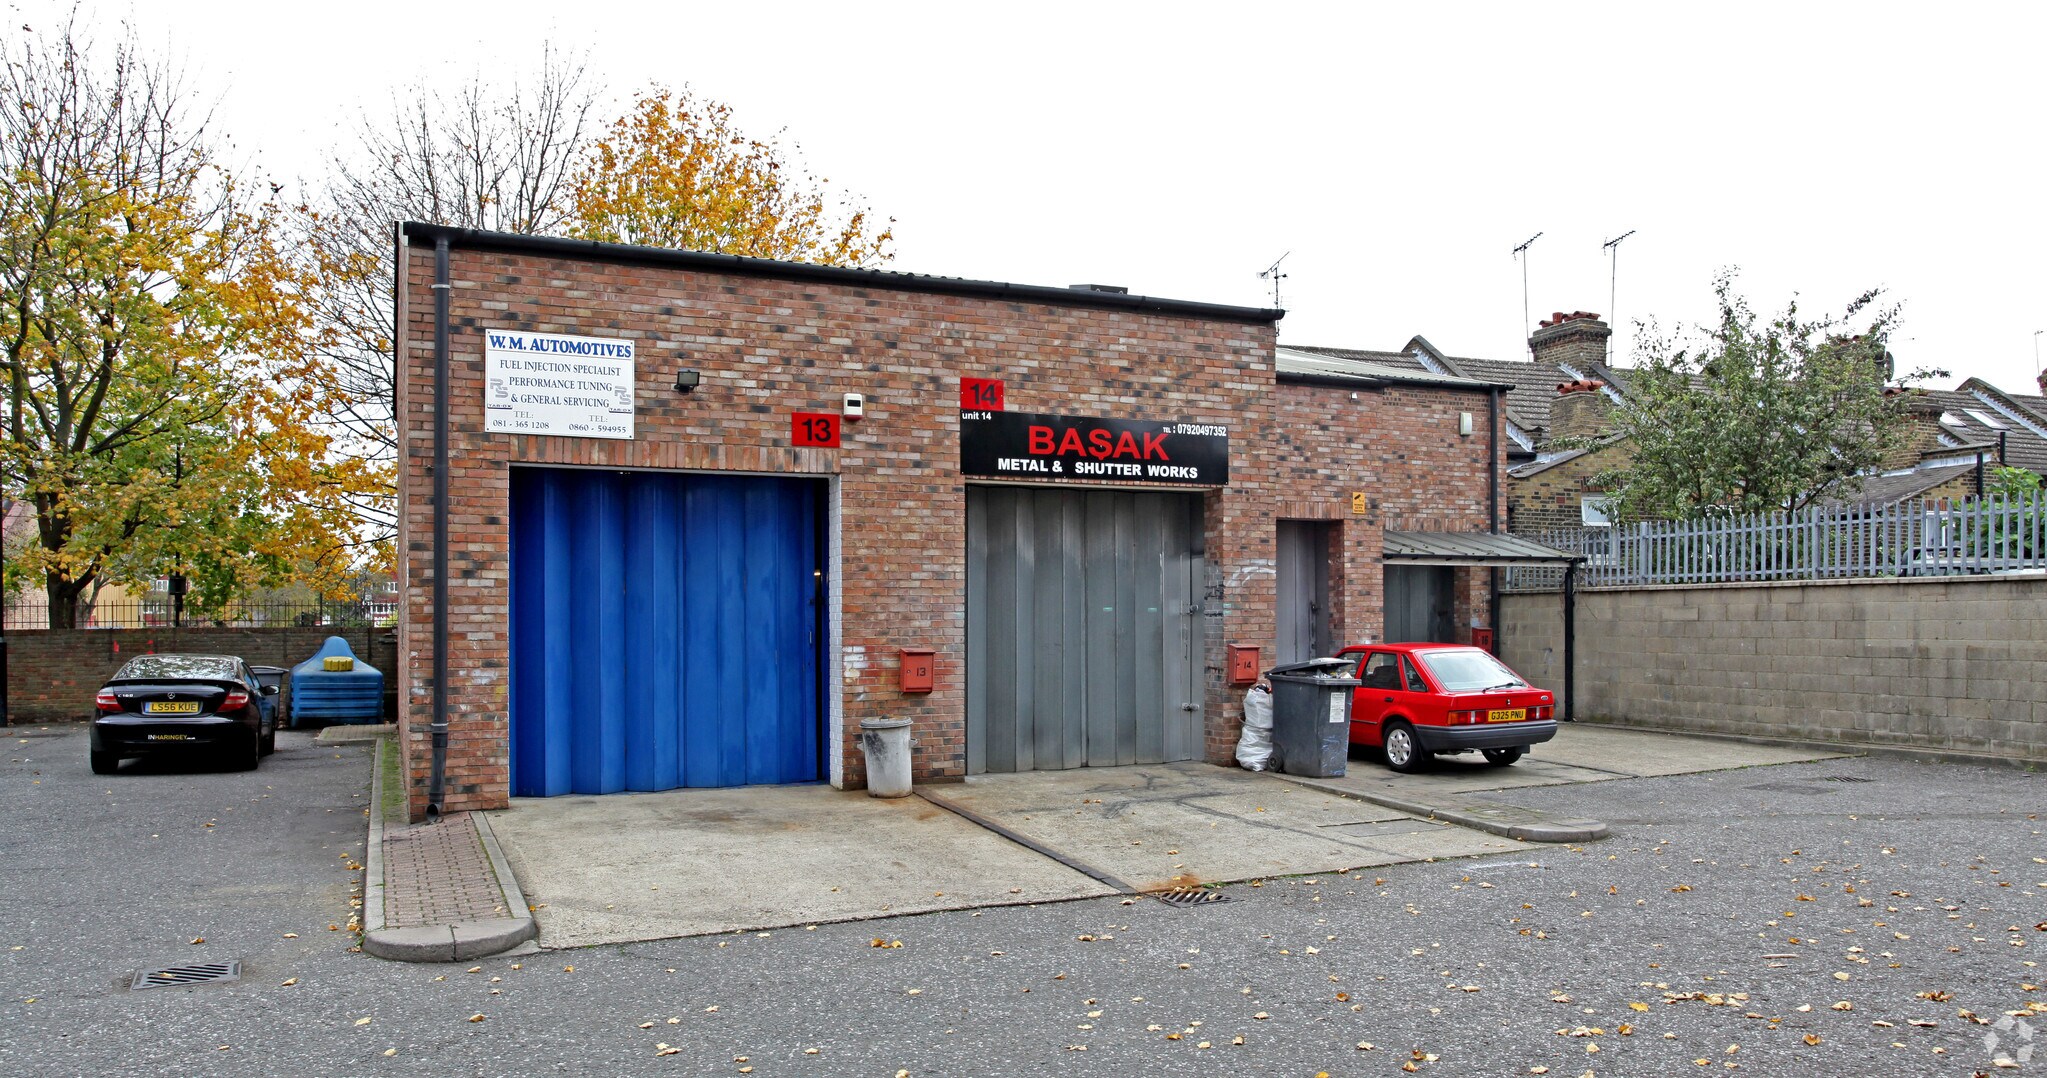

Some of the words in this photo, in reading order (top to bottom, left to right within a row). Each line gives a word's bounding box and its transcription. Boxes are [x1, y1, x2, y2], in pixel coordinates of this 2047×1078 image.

[530, 338, 632, 358] AUTOMOTIVES
[500, 359, 522, 370] FUEL
[524, 361, 571, 373] INJECTION
[573, 364, 621, 376] SPECIALIST
[509, 376, 575, 389] PERFORMANCE
[577, 381, 612, 392] TUNING
[970, 383, 998, 406] 14
[511, 393, 518, 403] &
[520, 394, 562, 405] GENERAL
[563, 396, 610, 408] SERVICING
[514, 411, 534, 419] TEL:
[589, 415, 608, 423] TEL:
[962, 411, 979, 420] unit
[981, 412, 992, 420] 14
[492, 419, 507, 427] 081
[515, 420, 529, 428] 365
[531, 421, 550, 429] 1208
[568, 423, 589, 431] 0860
[597, 425, 627, 433] 594955
[801, 418, 832, 442] 13
[1177, 423, 1227, 437] 07920497352
[997, 458, 1049, 472] METAL
[1052, 460, 1063, 473] &
[1075, 461, 1142, 476] SHUTTER
[1147, 464, 1198, 479] WORKS
[1243, 661, 1252, 669] 14
[916, 667, 926, 677] 13
[151, 703, 176, 711] LS56
[178, 703, 197, 711] KUE
[1491, 711, 1510, 720] G325
[1510, 710, 1524, 719] PNU
